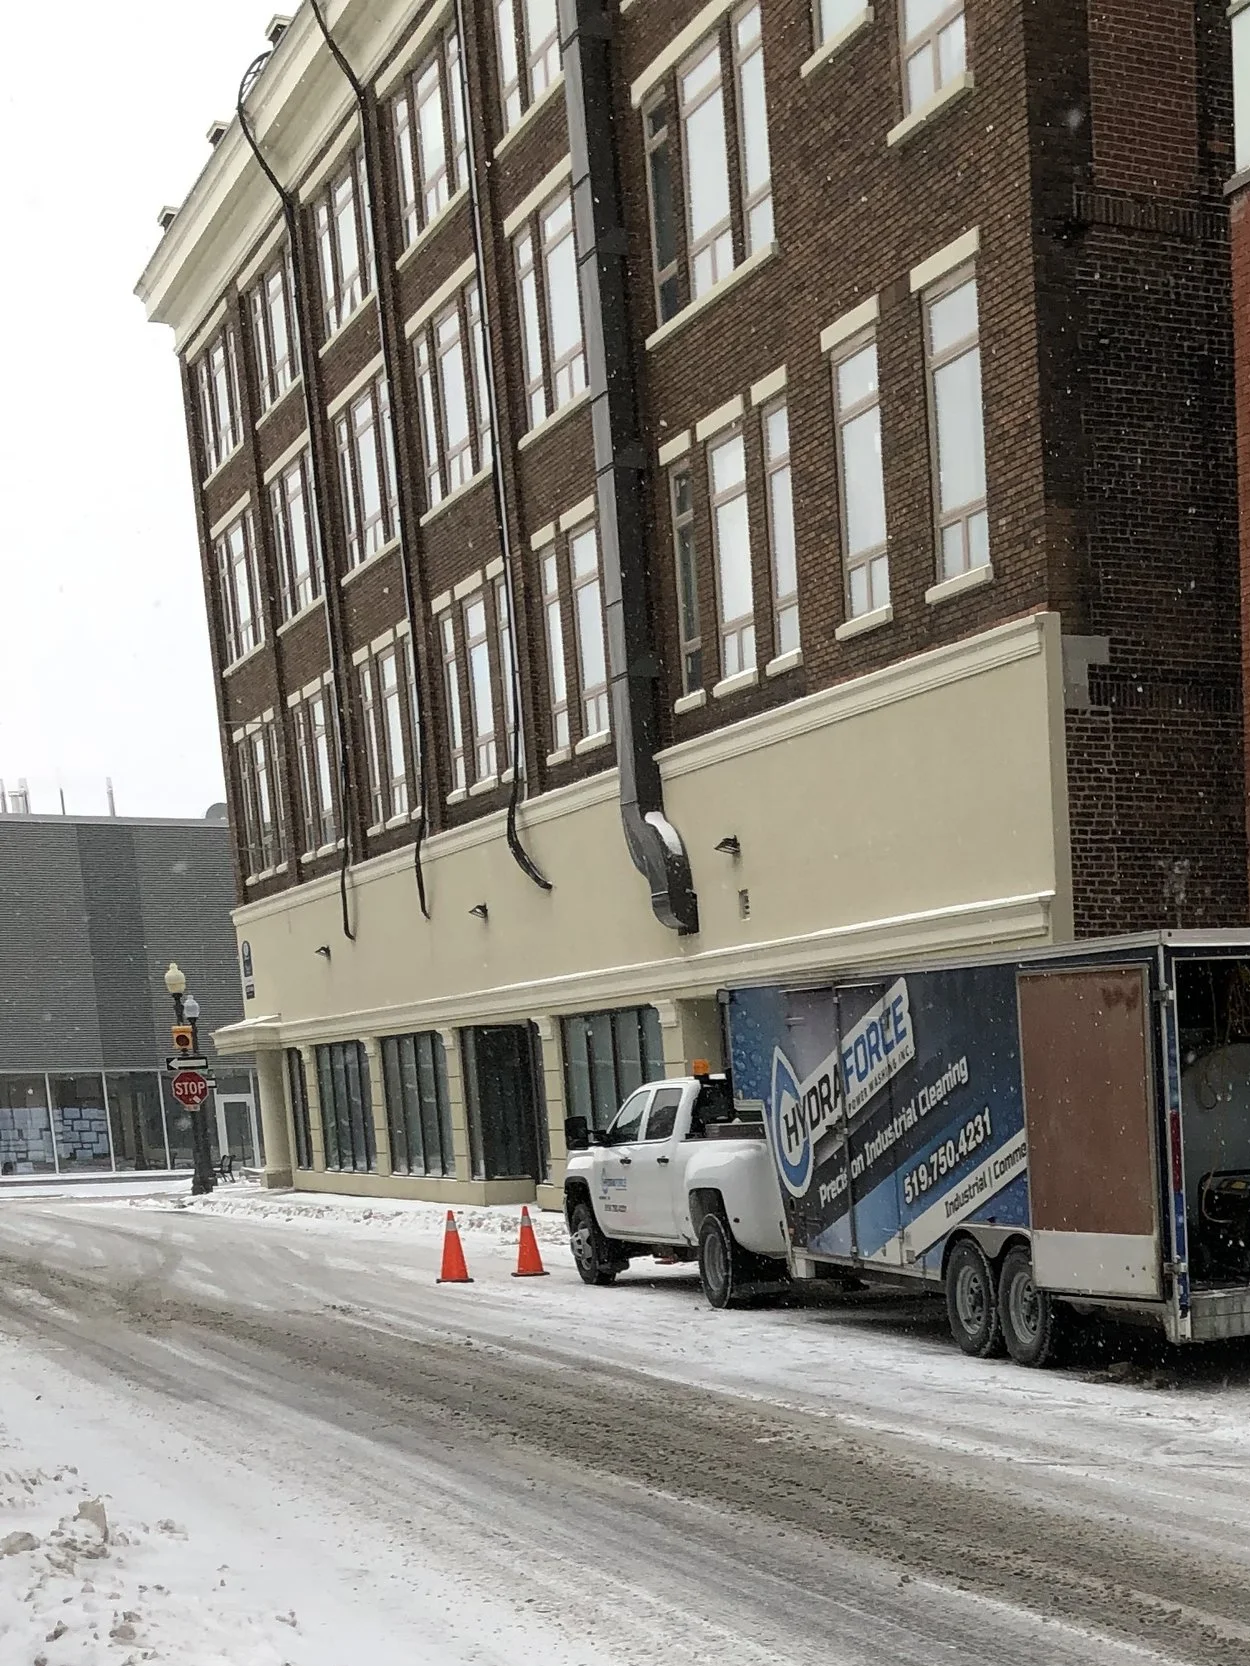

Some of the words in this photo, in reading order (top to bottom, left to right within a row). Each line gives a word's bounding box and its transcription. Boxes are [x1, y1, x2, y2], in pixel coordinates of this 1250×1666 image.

[175, 1081, 206, 1096] STOP
[864, 1098, 918, 1166] Industrial
[918, 1056, 969, 1116] Cleaning
[903, 1106, 992, 1204] 519.750.4231
[944, 1170, 988, 1219] Industrial
[993, 1142, 1027, 1180] Comme
